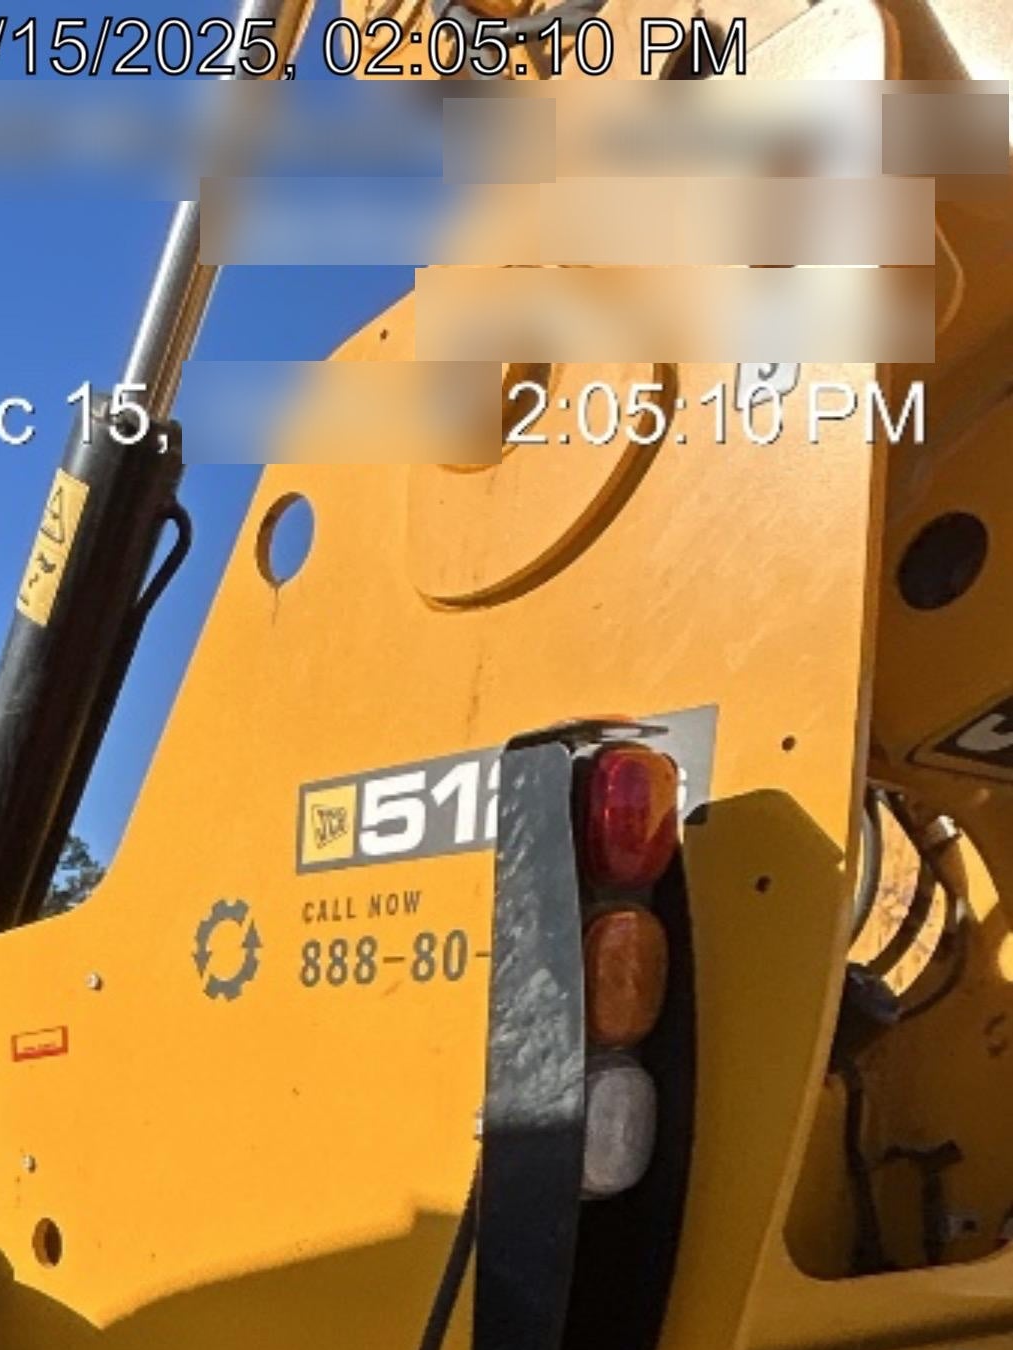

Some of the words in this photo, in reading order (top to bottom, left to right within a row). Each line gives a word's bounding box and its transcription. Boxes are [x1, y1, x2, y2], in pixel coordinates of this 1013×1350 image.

[359, 758, 501, 856] 51
[302, 896, 357, 923] CALL
[368, 890, 422, 919] NOW
